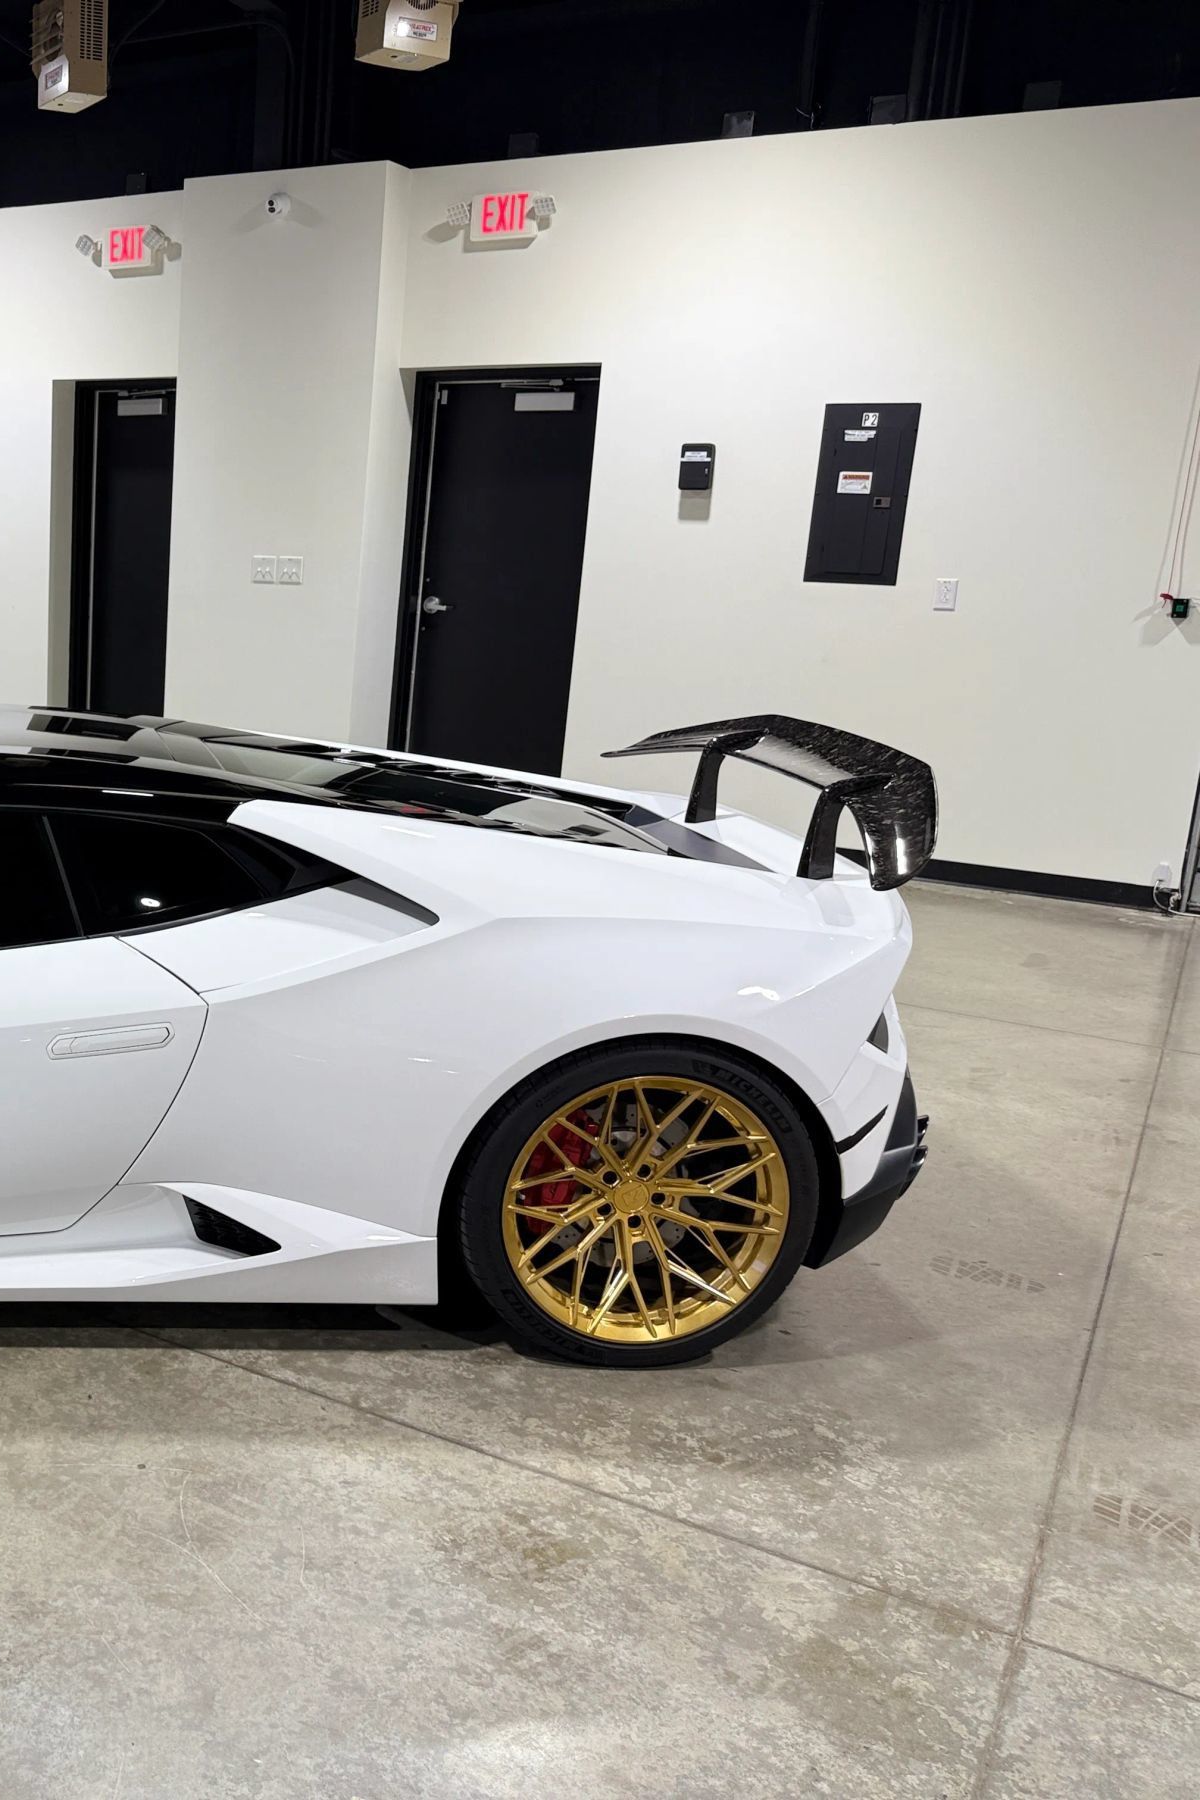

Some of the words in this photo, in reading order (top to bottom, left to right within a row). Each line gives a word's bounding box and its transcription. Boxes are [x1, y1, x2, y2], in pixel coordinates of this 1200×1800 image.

[482, 193, 529, 233] EXIT
[110, 227, 145, 262] EXIT
[714, 1067, 790, 1131] MICHELIN
